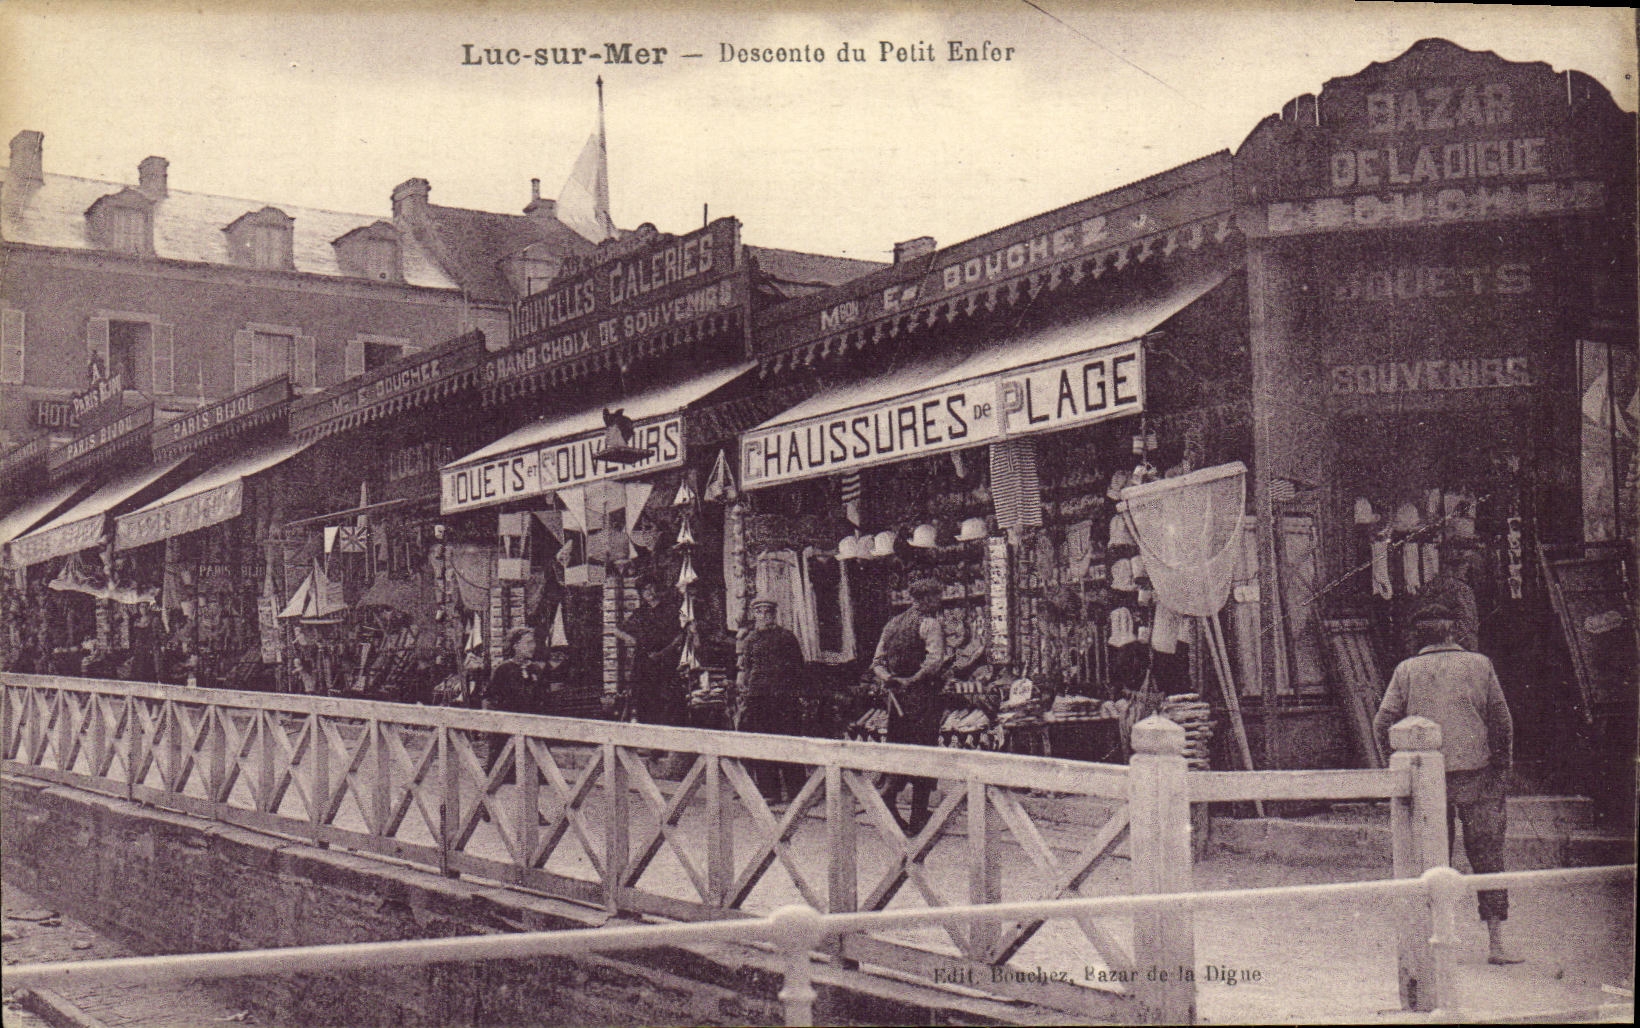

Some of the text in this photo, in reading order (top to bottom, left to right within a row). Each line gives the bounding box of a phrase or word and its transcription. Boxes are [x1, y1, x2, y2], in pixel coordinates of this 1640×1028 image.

[1367, 83, 1513, 133] BAZAR
[1331, 137, 1547, 187] DE LA DIGUE
[510, 278, 596, 340] NOUVELLES
[609, 233, 714, 305] GALERIES
[541, 328, 592, 364] CHOIX
[599, 317, 618, 346] DE
[623, 280, 732, 337] SOUVENIRS
[1331, 356, 1533, 395] SOUVENIRS
[67, 436, 96, 460] PARIS
[100, 415, 133, 446] BIJOU
[173, 395, 255, 438] PARIS BIJOU
[744, 393, 968, 482] CHAUSSURES
[1002, 353, 1138, 434] PLAGE
